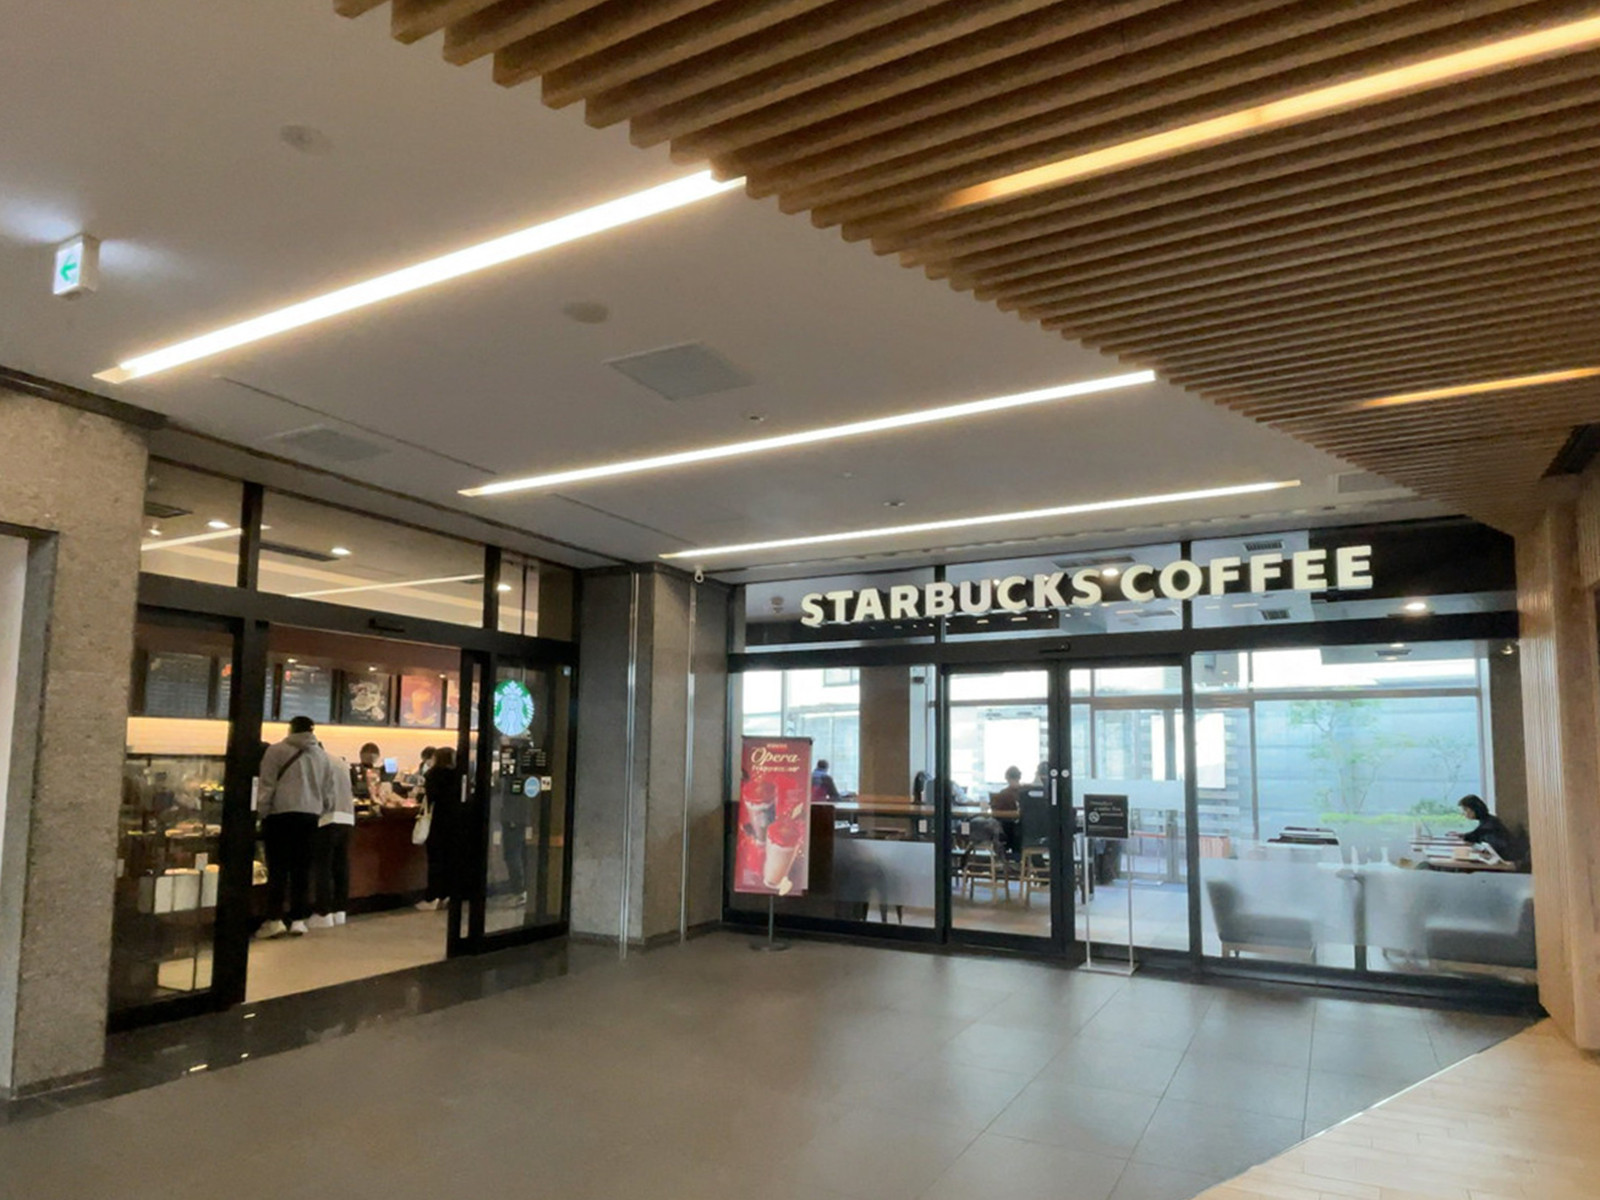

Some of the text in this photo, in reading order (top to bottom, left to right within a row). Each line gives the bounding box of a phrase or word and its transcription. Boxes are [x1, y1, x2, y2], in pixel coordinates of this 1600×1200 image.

[800, 545, 1374, 628] STARBUCKS COFFEE
[750, 746, 800, 766] Opera
